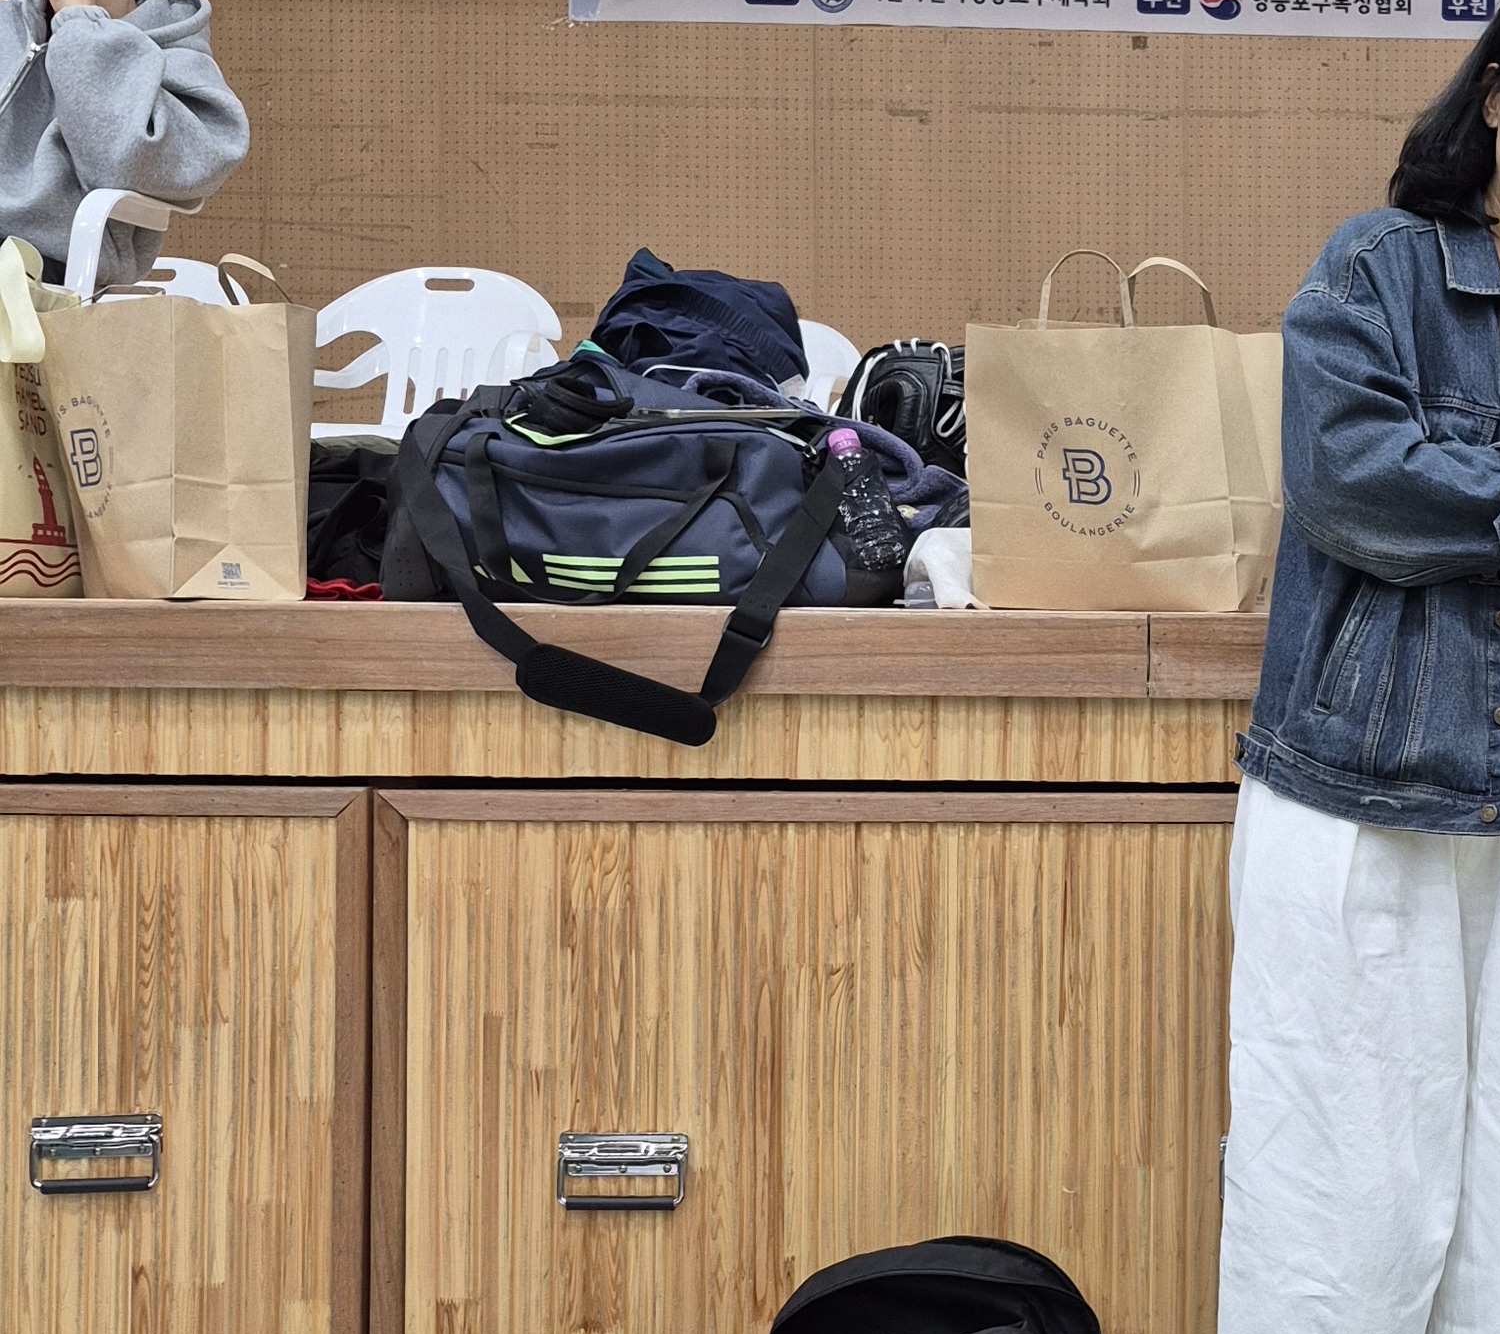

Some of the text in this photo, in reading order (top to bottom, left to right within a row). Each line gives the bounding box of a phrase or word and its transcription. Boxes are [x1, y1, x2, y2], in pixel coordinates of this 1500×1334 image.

[18, 410, 47, 437] SAND
[1036, 417, 1138, 463] PARIS BAGUETTE
[1044, 503, 1136, 537] BOULANGERIE
